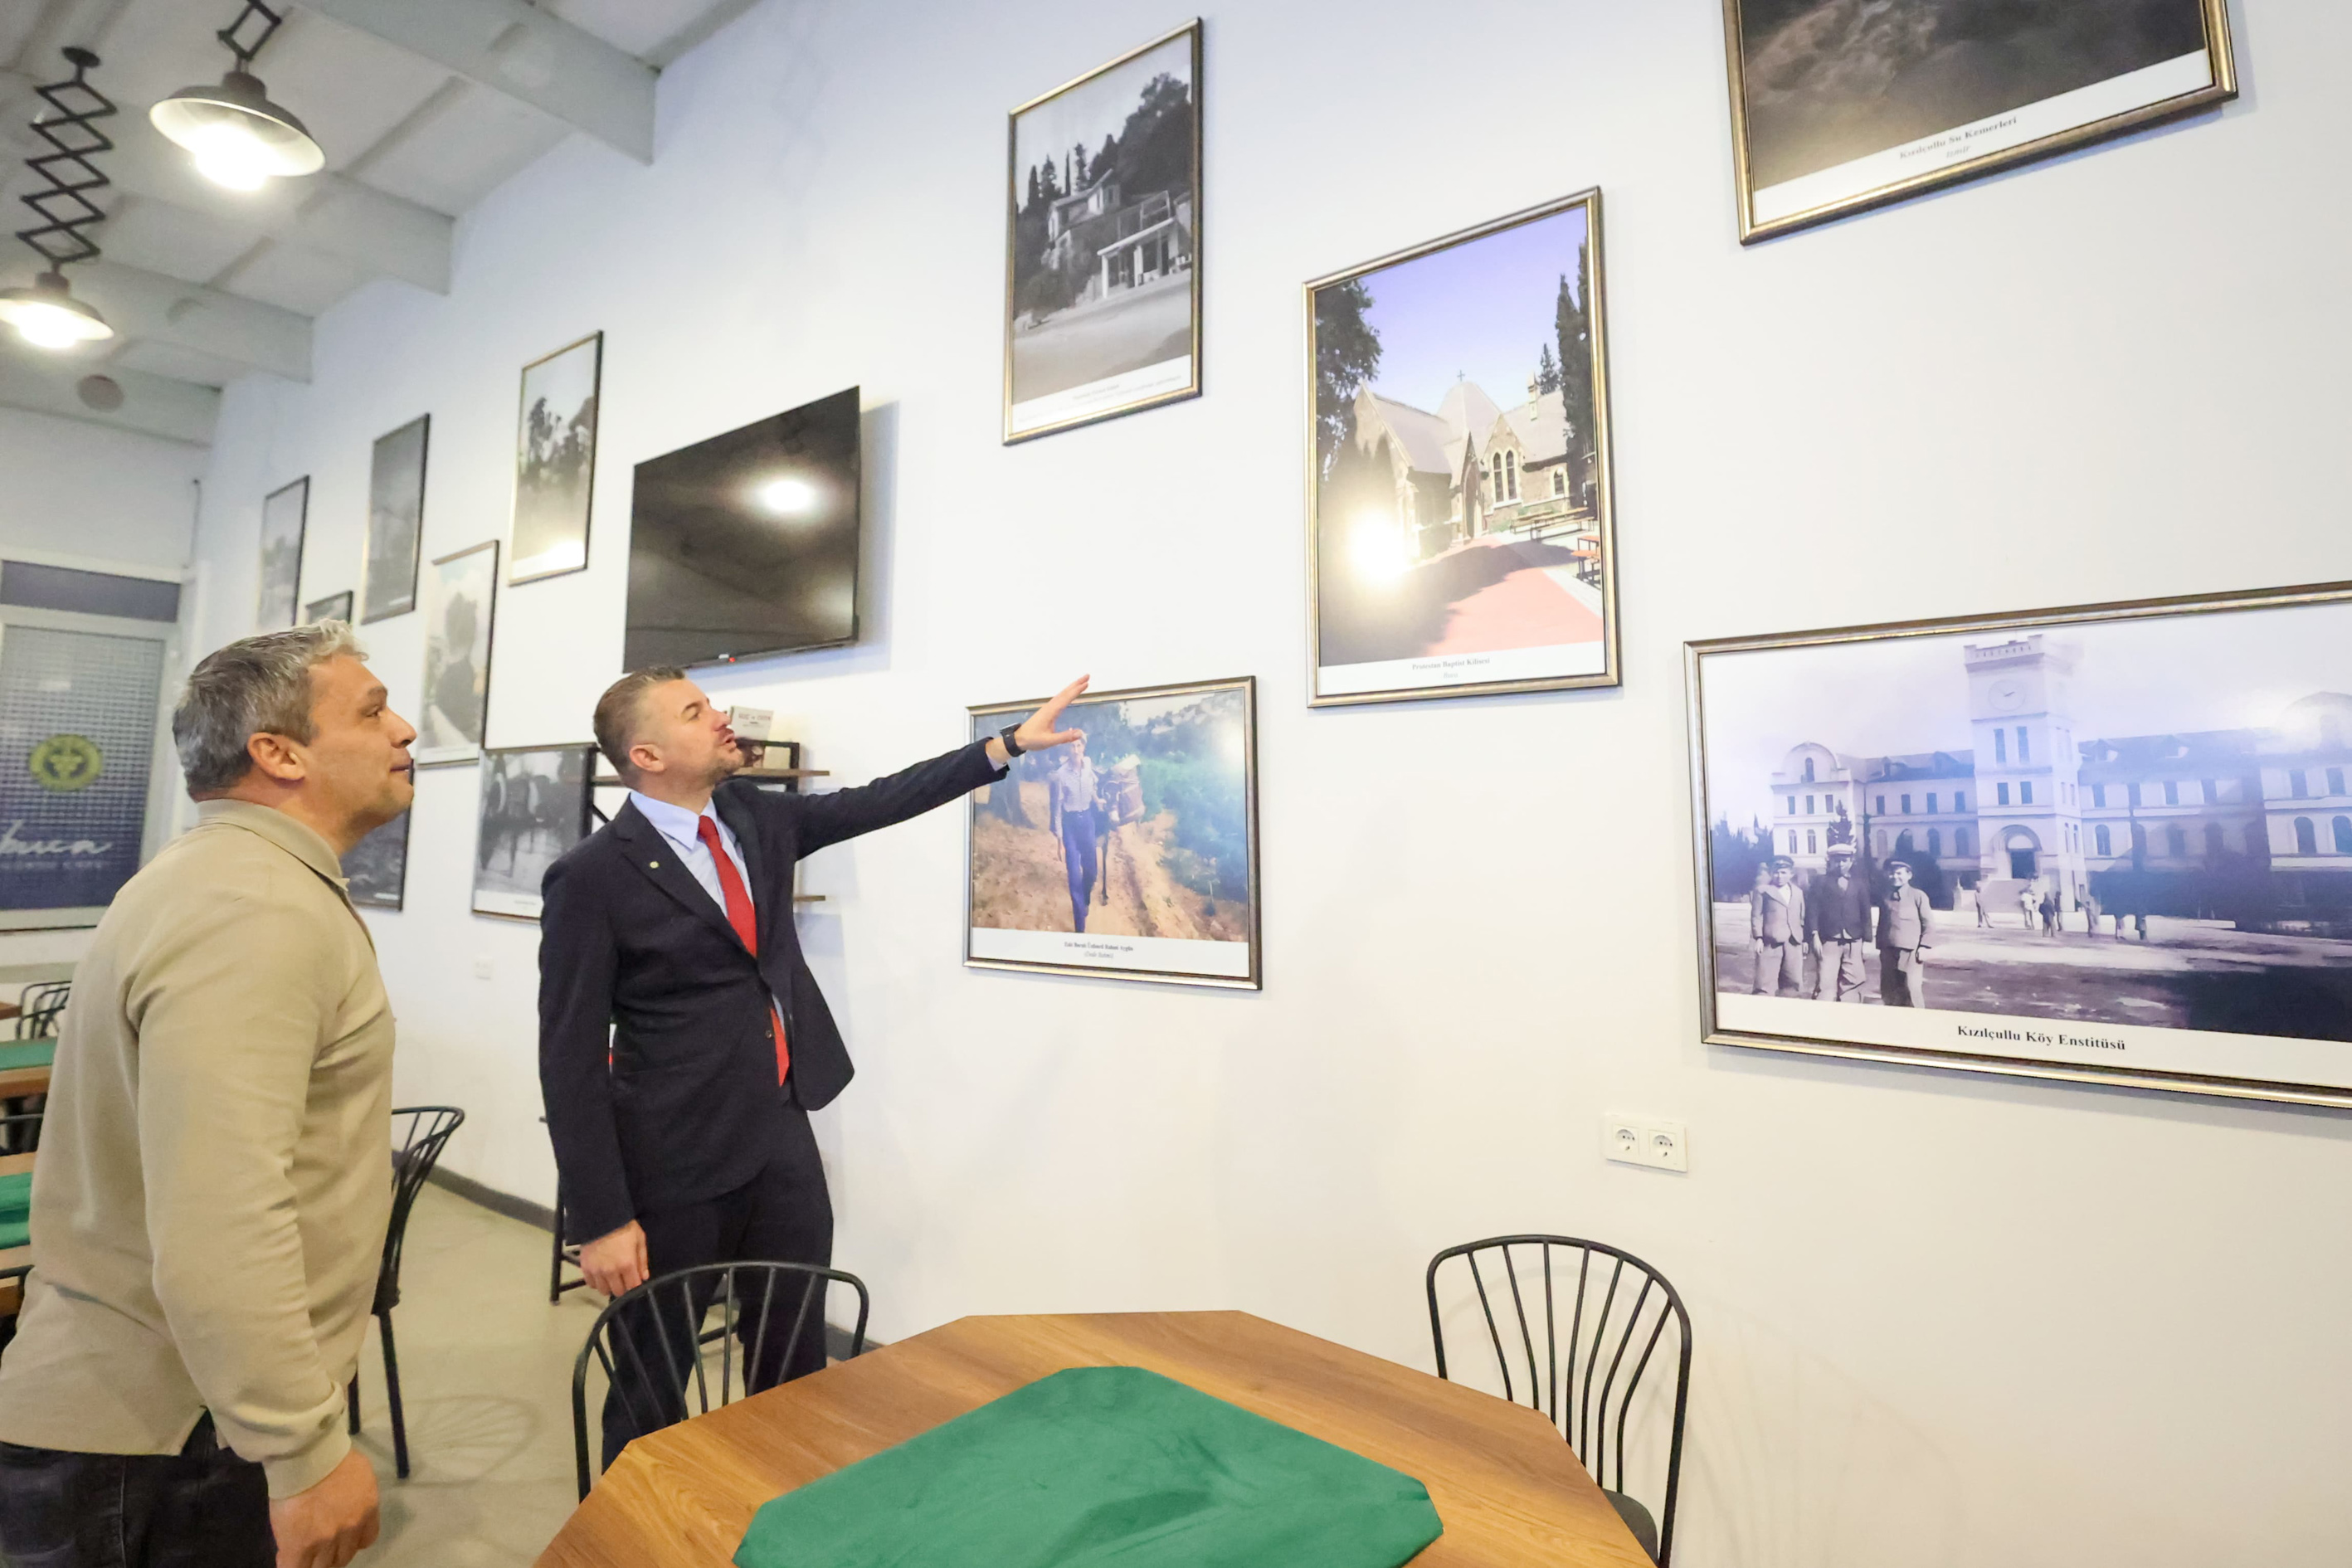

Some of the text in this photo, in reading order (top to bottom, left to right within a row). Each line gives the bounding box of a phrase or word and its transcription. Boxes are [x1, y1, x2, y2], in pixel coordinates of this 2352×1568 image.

[1949, 134, 1961, 144] Su
[1965, 116, 2017, 139] Kemerleri
[1443, 660, 1465, 669] Baptist
[1467, 657, 1490, 665] Kilisesi
[1957, 1025, 2126, 1050] Kızılçullu Köy Enstitüsü
